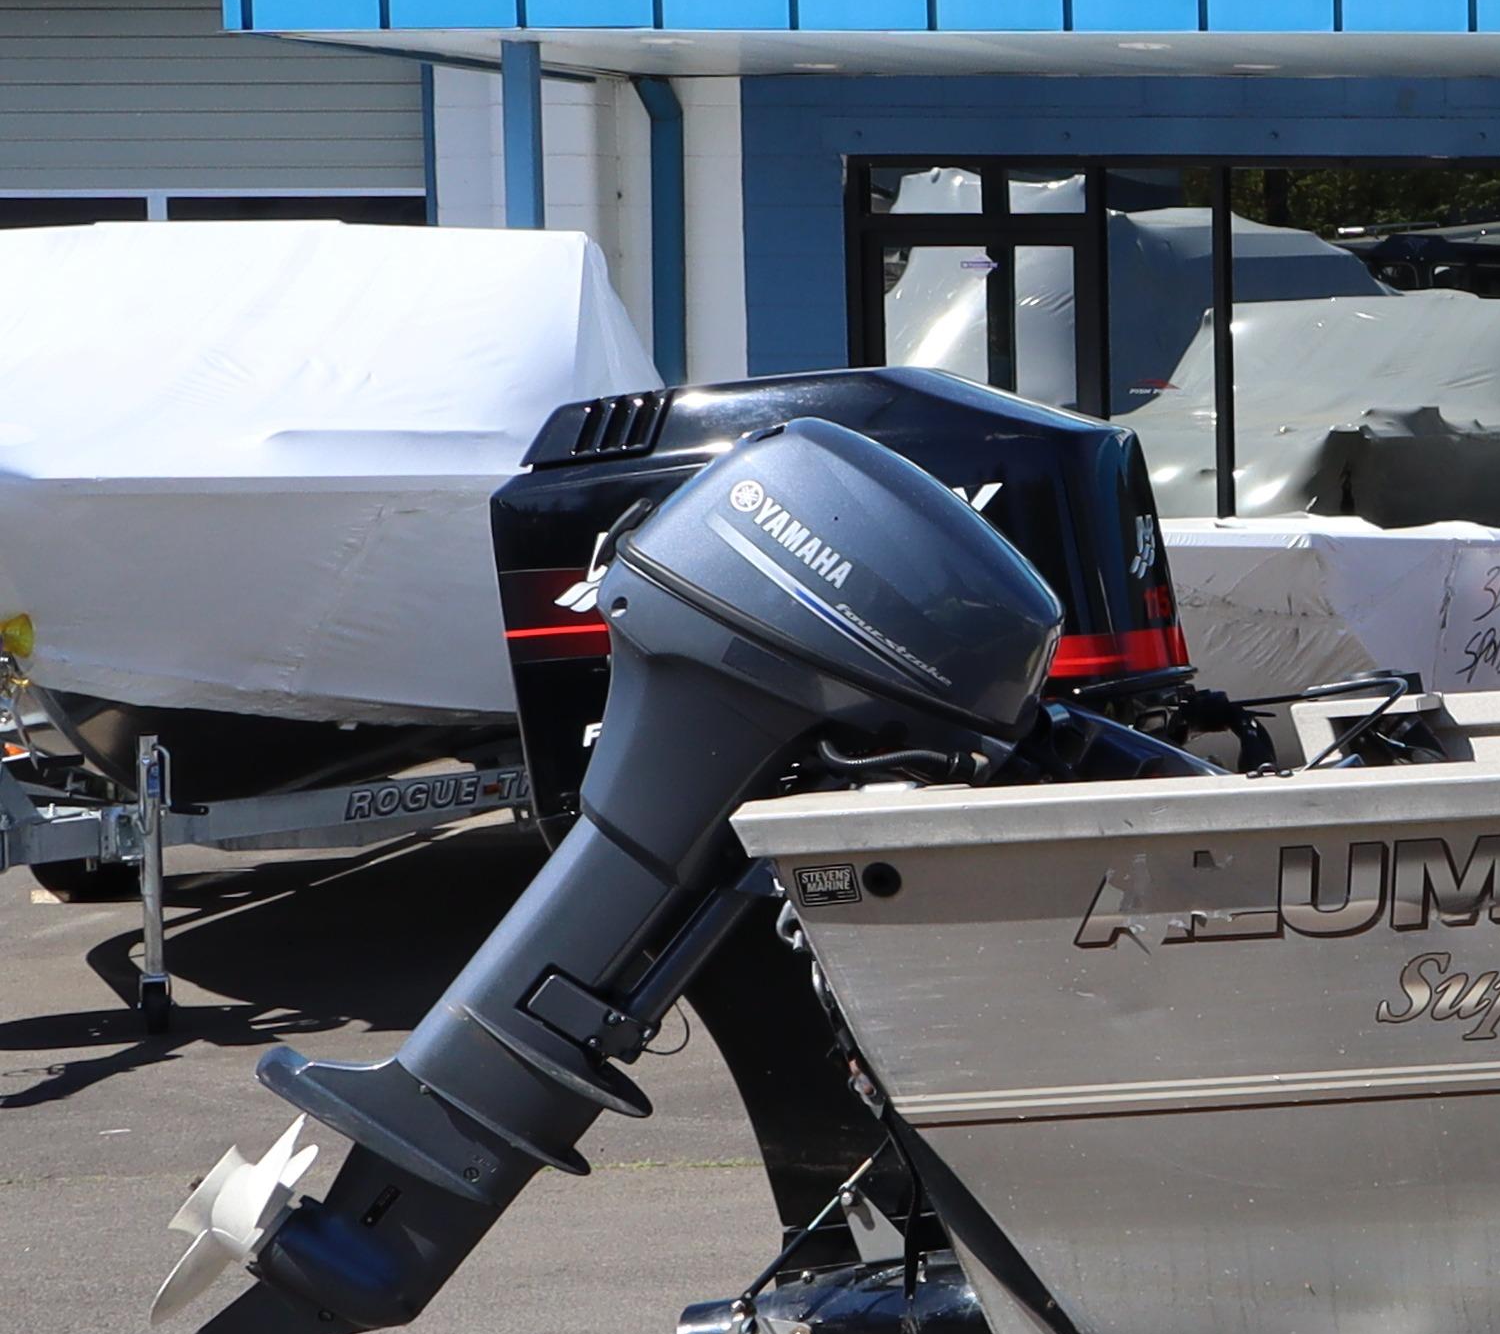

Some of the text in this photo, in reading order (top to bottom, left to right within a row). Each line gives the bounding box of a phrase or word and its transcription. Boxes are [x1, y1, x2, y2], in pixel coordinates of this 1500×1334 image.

[753, 496, 854, 590] YAMAHA
[344, 775, 481, 822] ROGUE
[801, 868, 851, 884] STEVENS
[806, 879, 851, 893] MARINE
